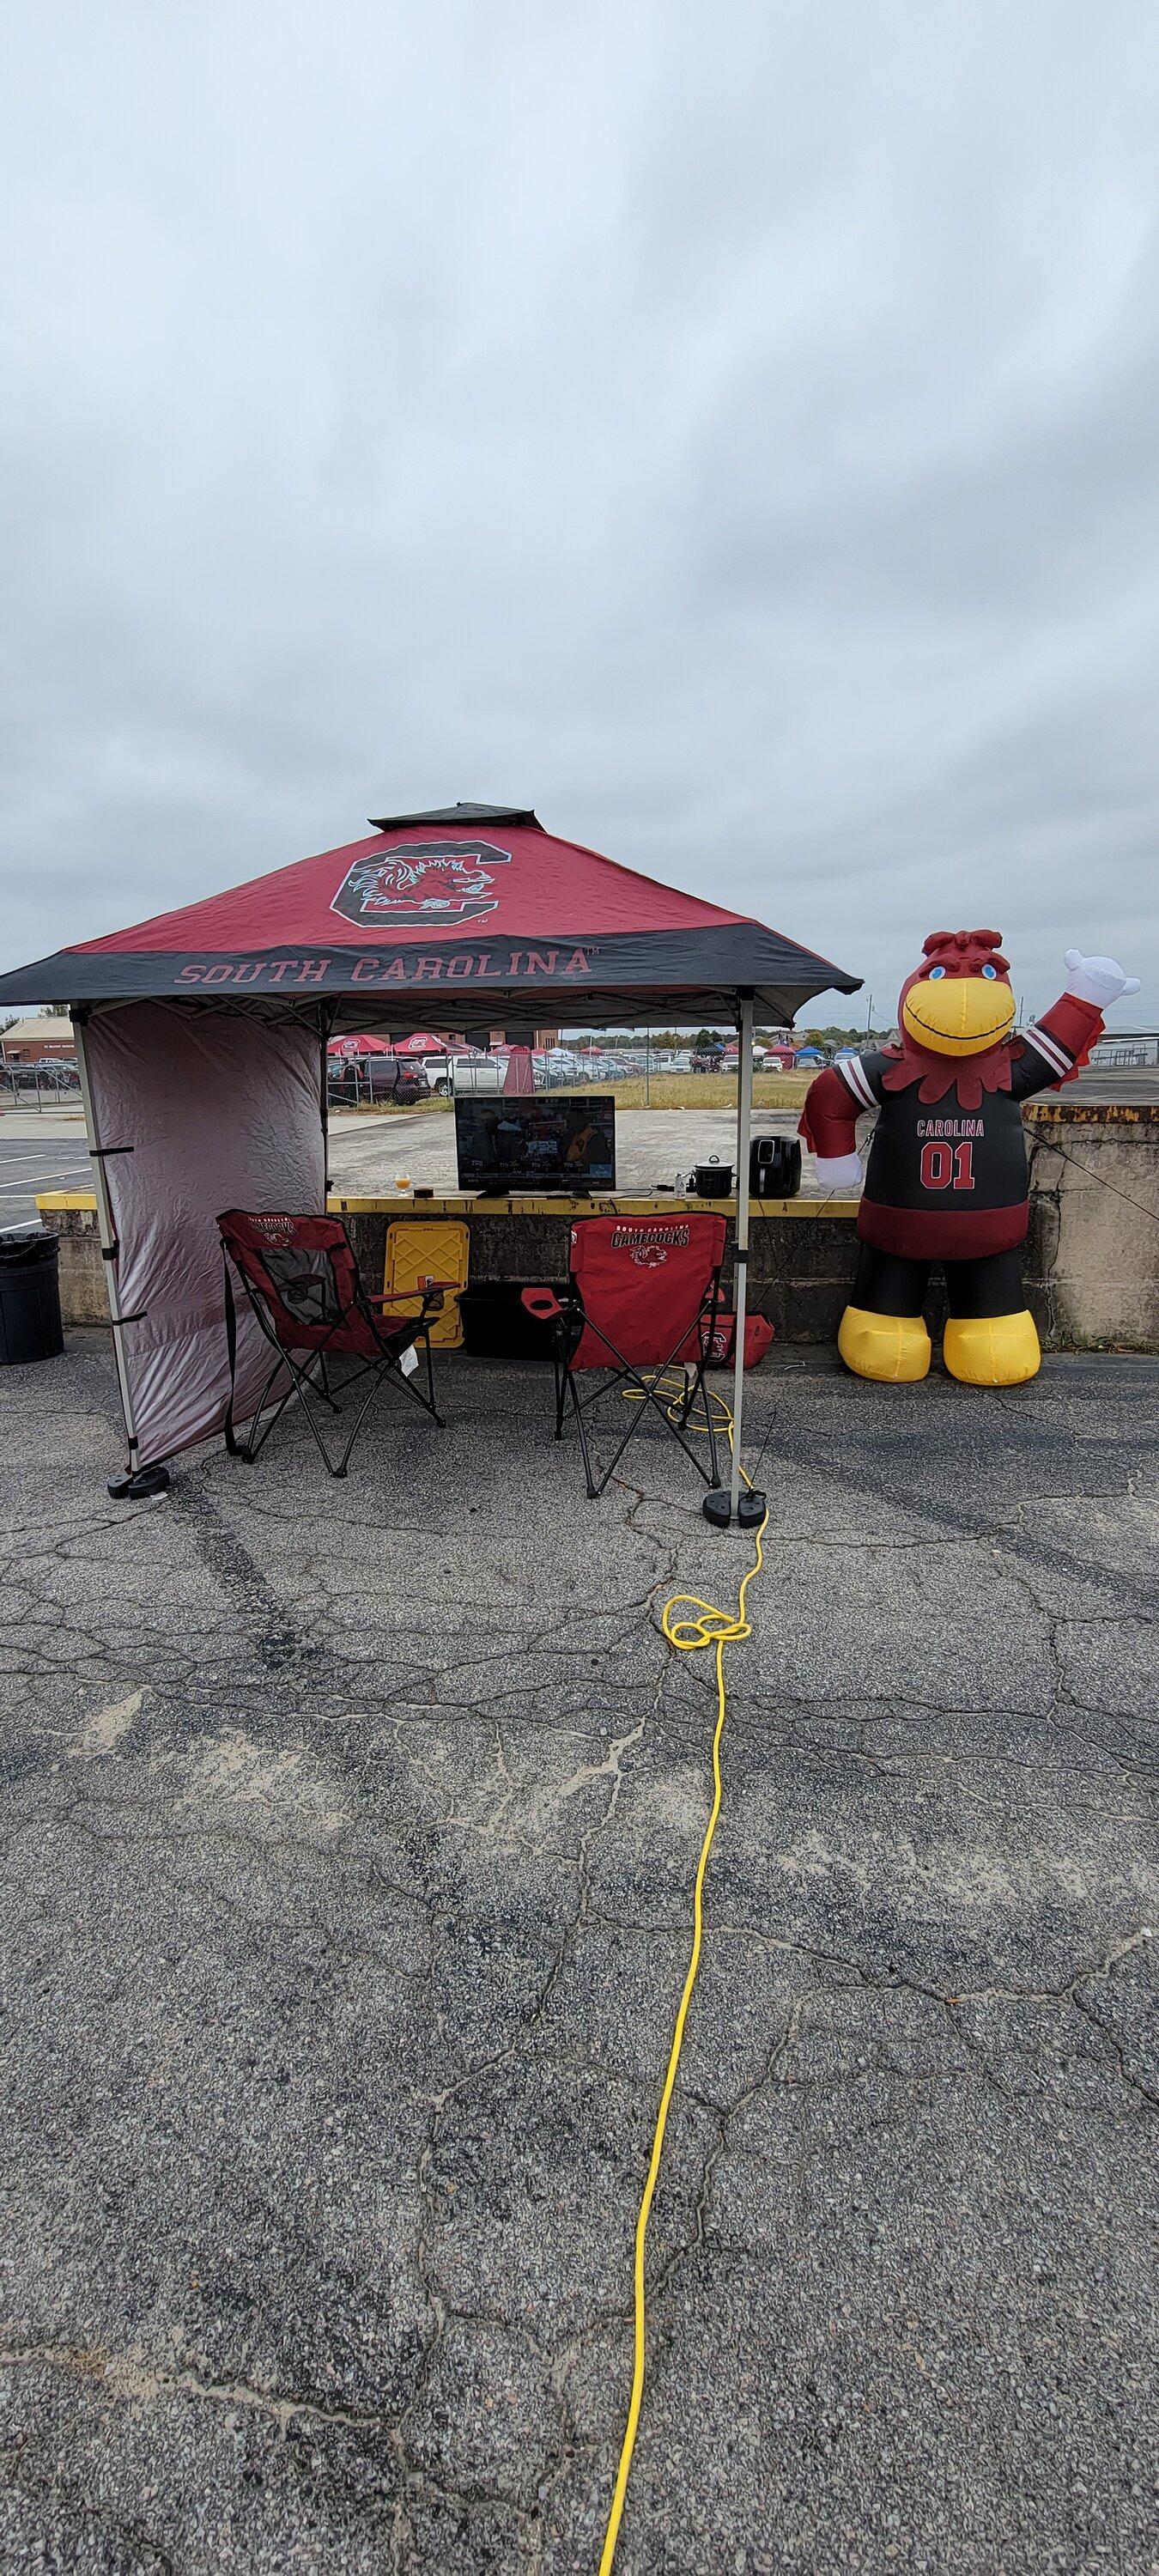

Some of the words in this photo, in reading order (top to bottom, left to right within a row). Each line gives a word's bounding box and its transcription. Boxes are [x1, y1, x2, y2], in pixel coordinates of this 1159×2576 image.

[173, 959, 332, 984] SOUTH
[350, 948, 592, 981] CAROLINA
[917, 1119, 985, 1137] CAROLINA
[919, 1141, 975, 1189] 01
[610, 1229, 689, 1249] GAMECOCKS
